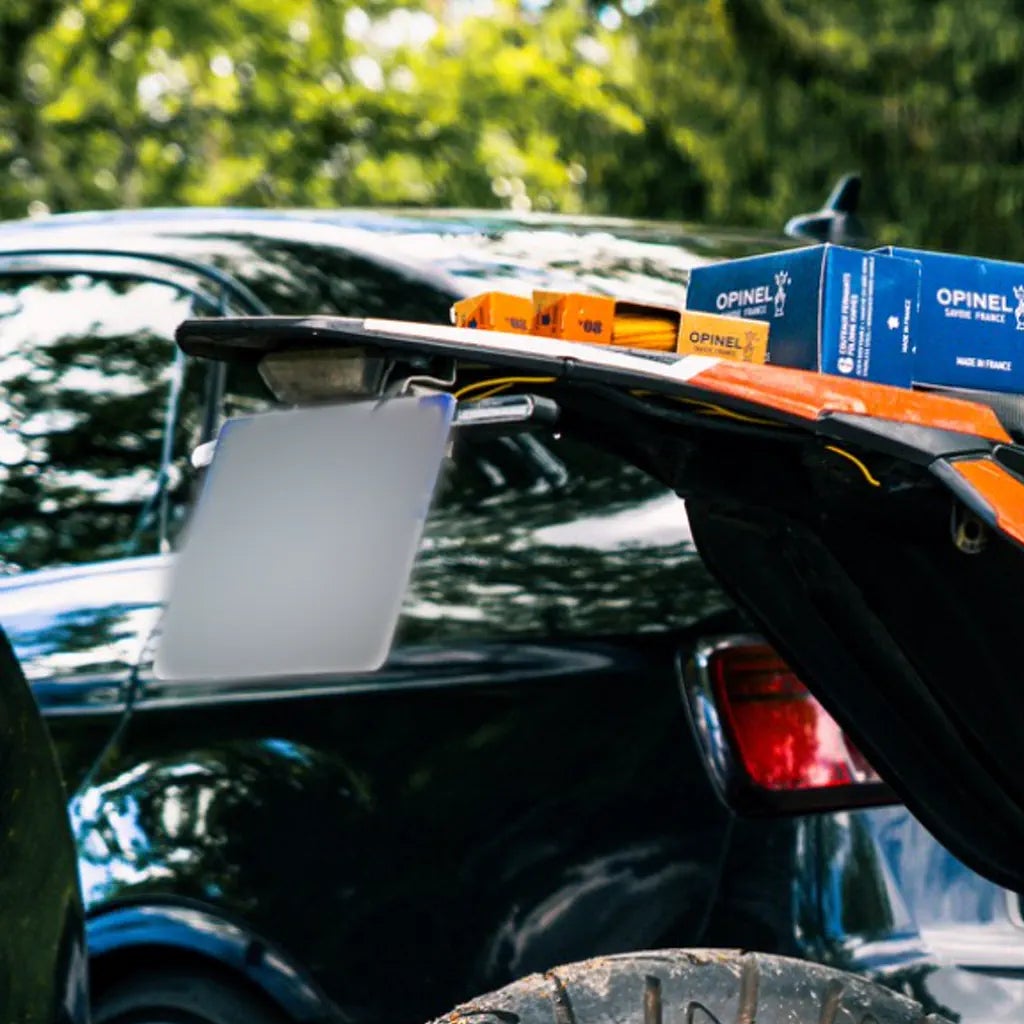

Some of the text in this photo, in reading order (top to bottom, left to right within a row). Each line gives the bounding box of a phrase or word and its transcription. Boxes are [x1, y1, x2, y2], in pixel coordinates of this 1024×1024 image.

[716, 285, 773, 310] OPINEL
[937, 288, 1013, 313] OPINEL
[689, 330, 742, 349] OPINEL
